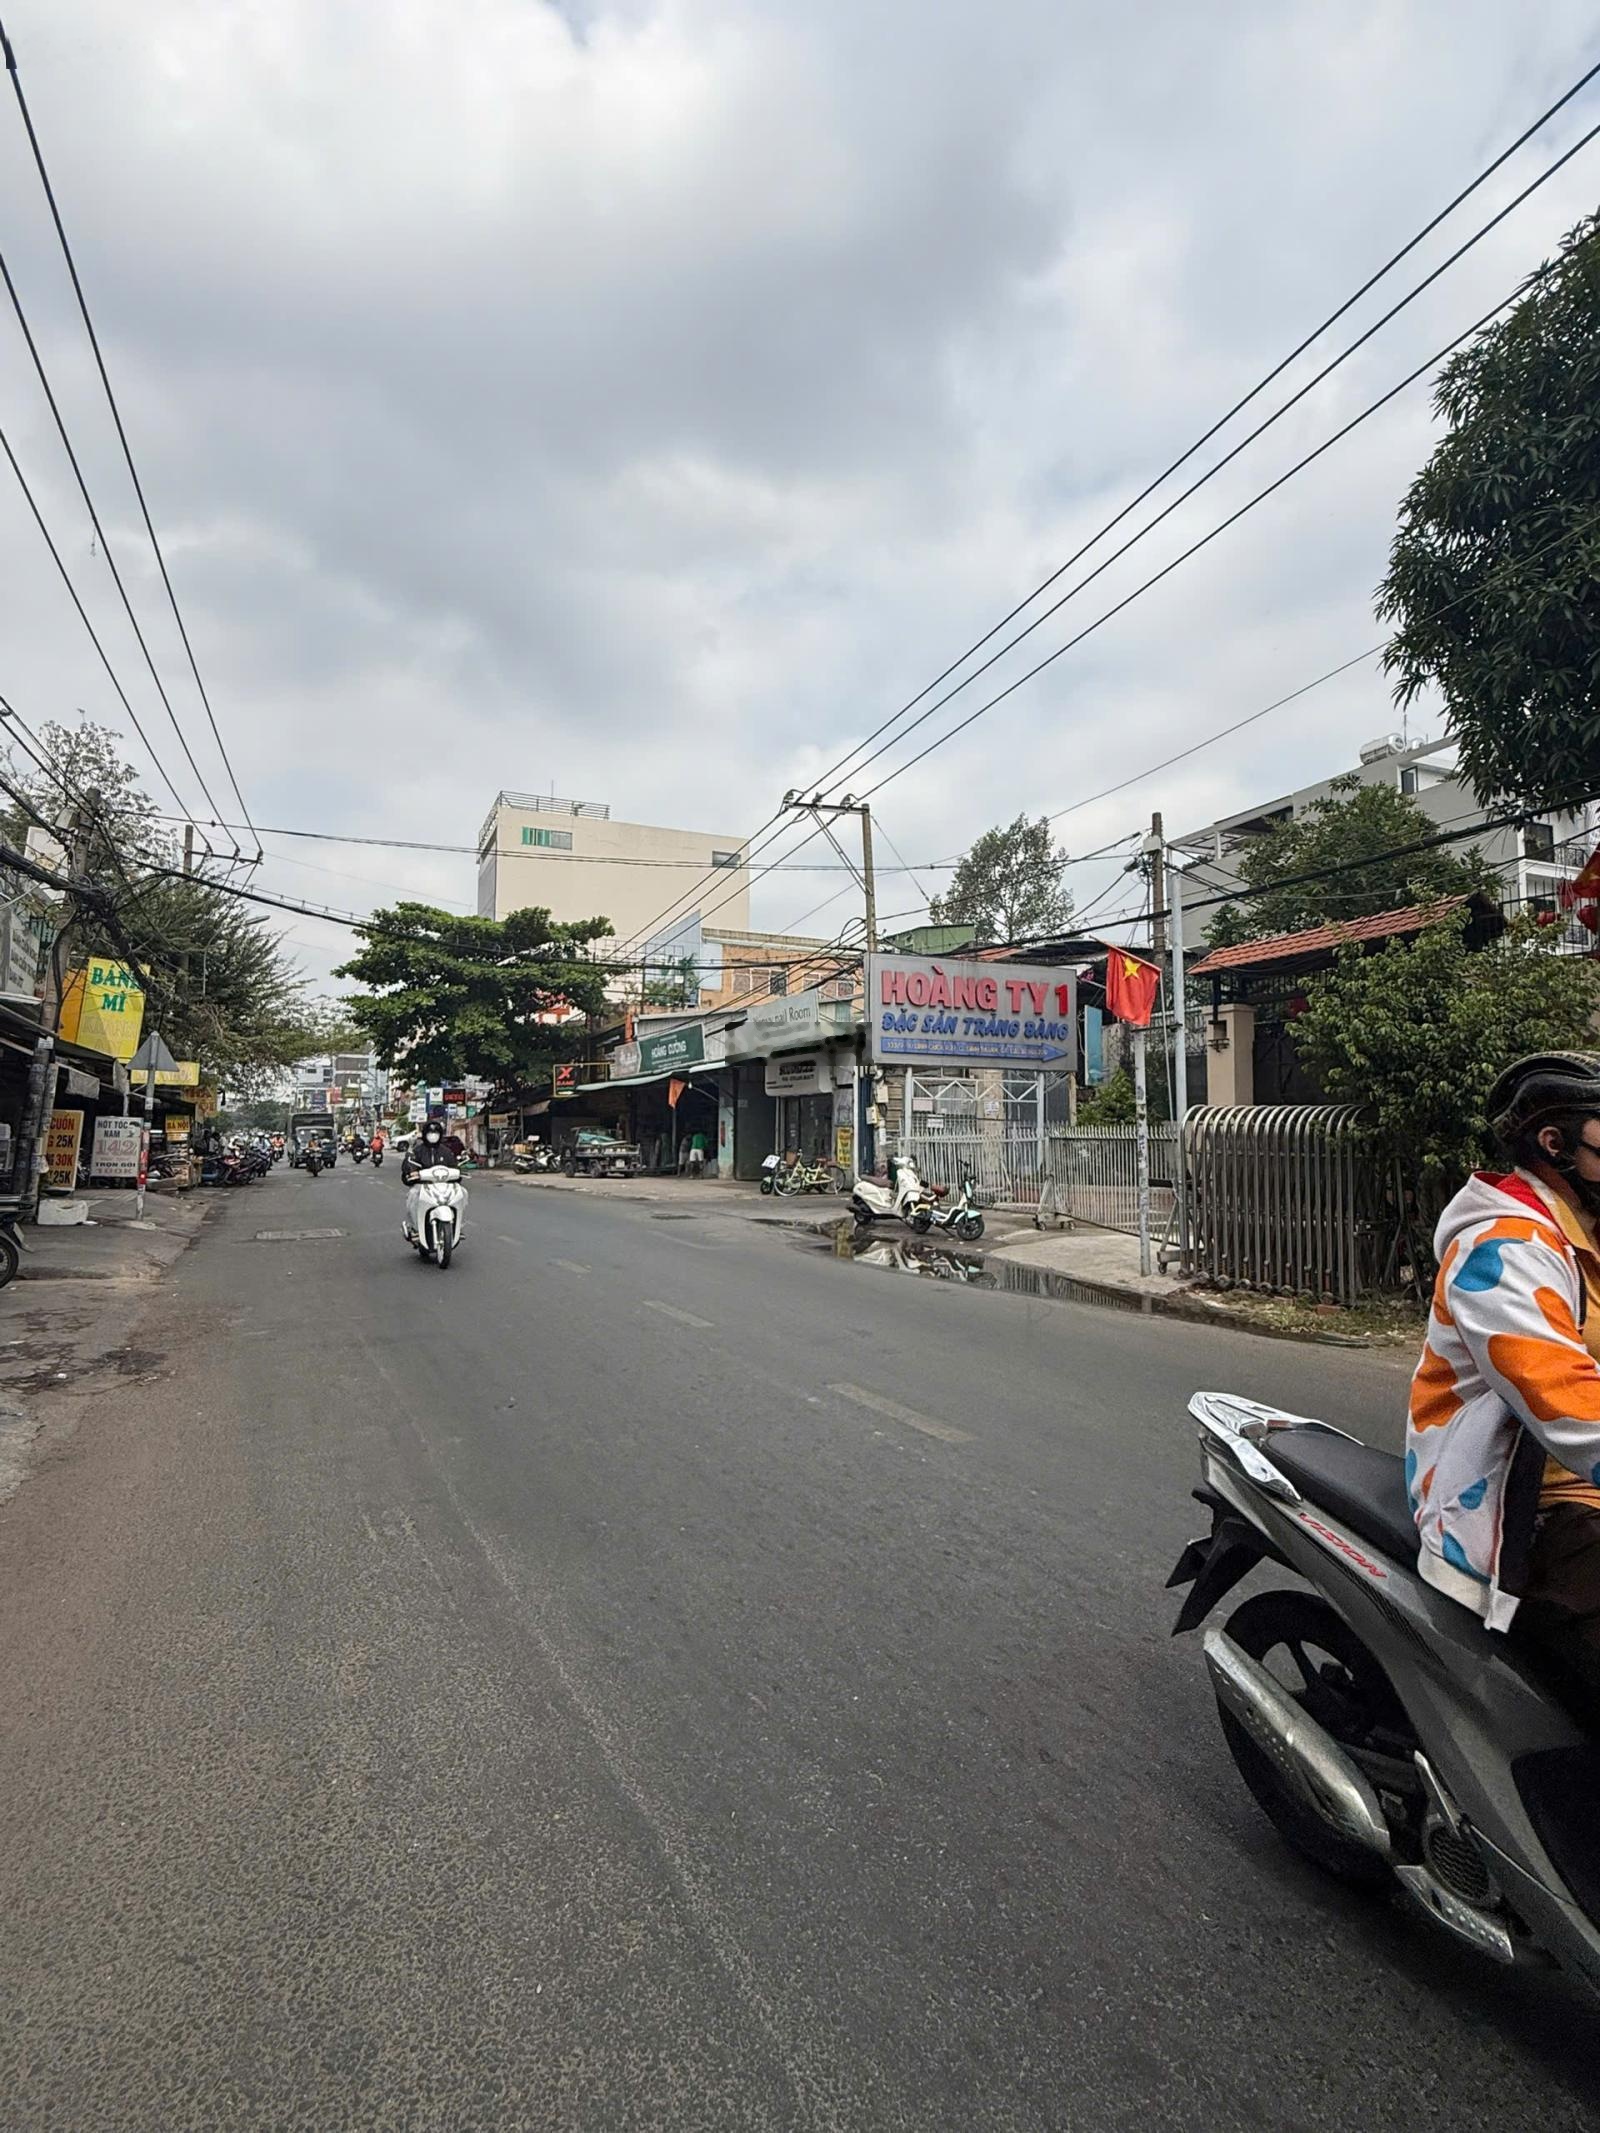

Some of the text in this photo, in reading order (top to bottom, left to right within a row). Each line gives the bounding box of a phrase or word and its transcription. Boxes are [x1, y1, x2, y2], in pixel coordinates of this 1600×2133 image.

[881, 965, 1069, 1017] HOÀNG TY 1
[789, 1006, 811, 1021] Room
[921, 1010, 958, 1034] SẢN
[1024, 1018, 1069, 1041] BÀNG
[103, 1130, 120, 1138] NAM
[56, 1135, 74, 1148] 25K
[55, 1154, 73, 1167] 30K
[53, 1170, 71, 1184] 25K
[1299, 1513, 1387, 1578] VISION
